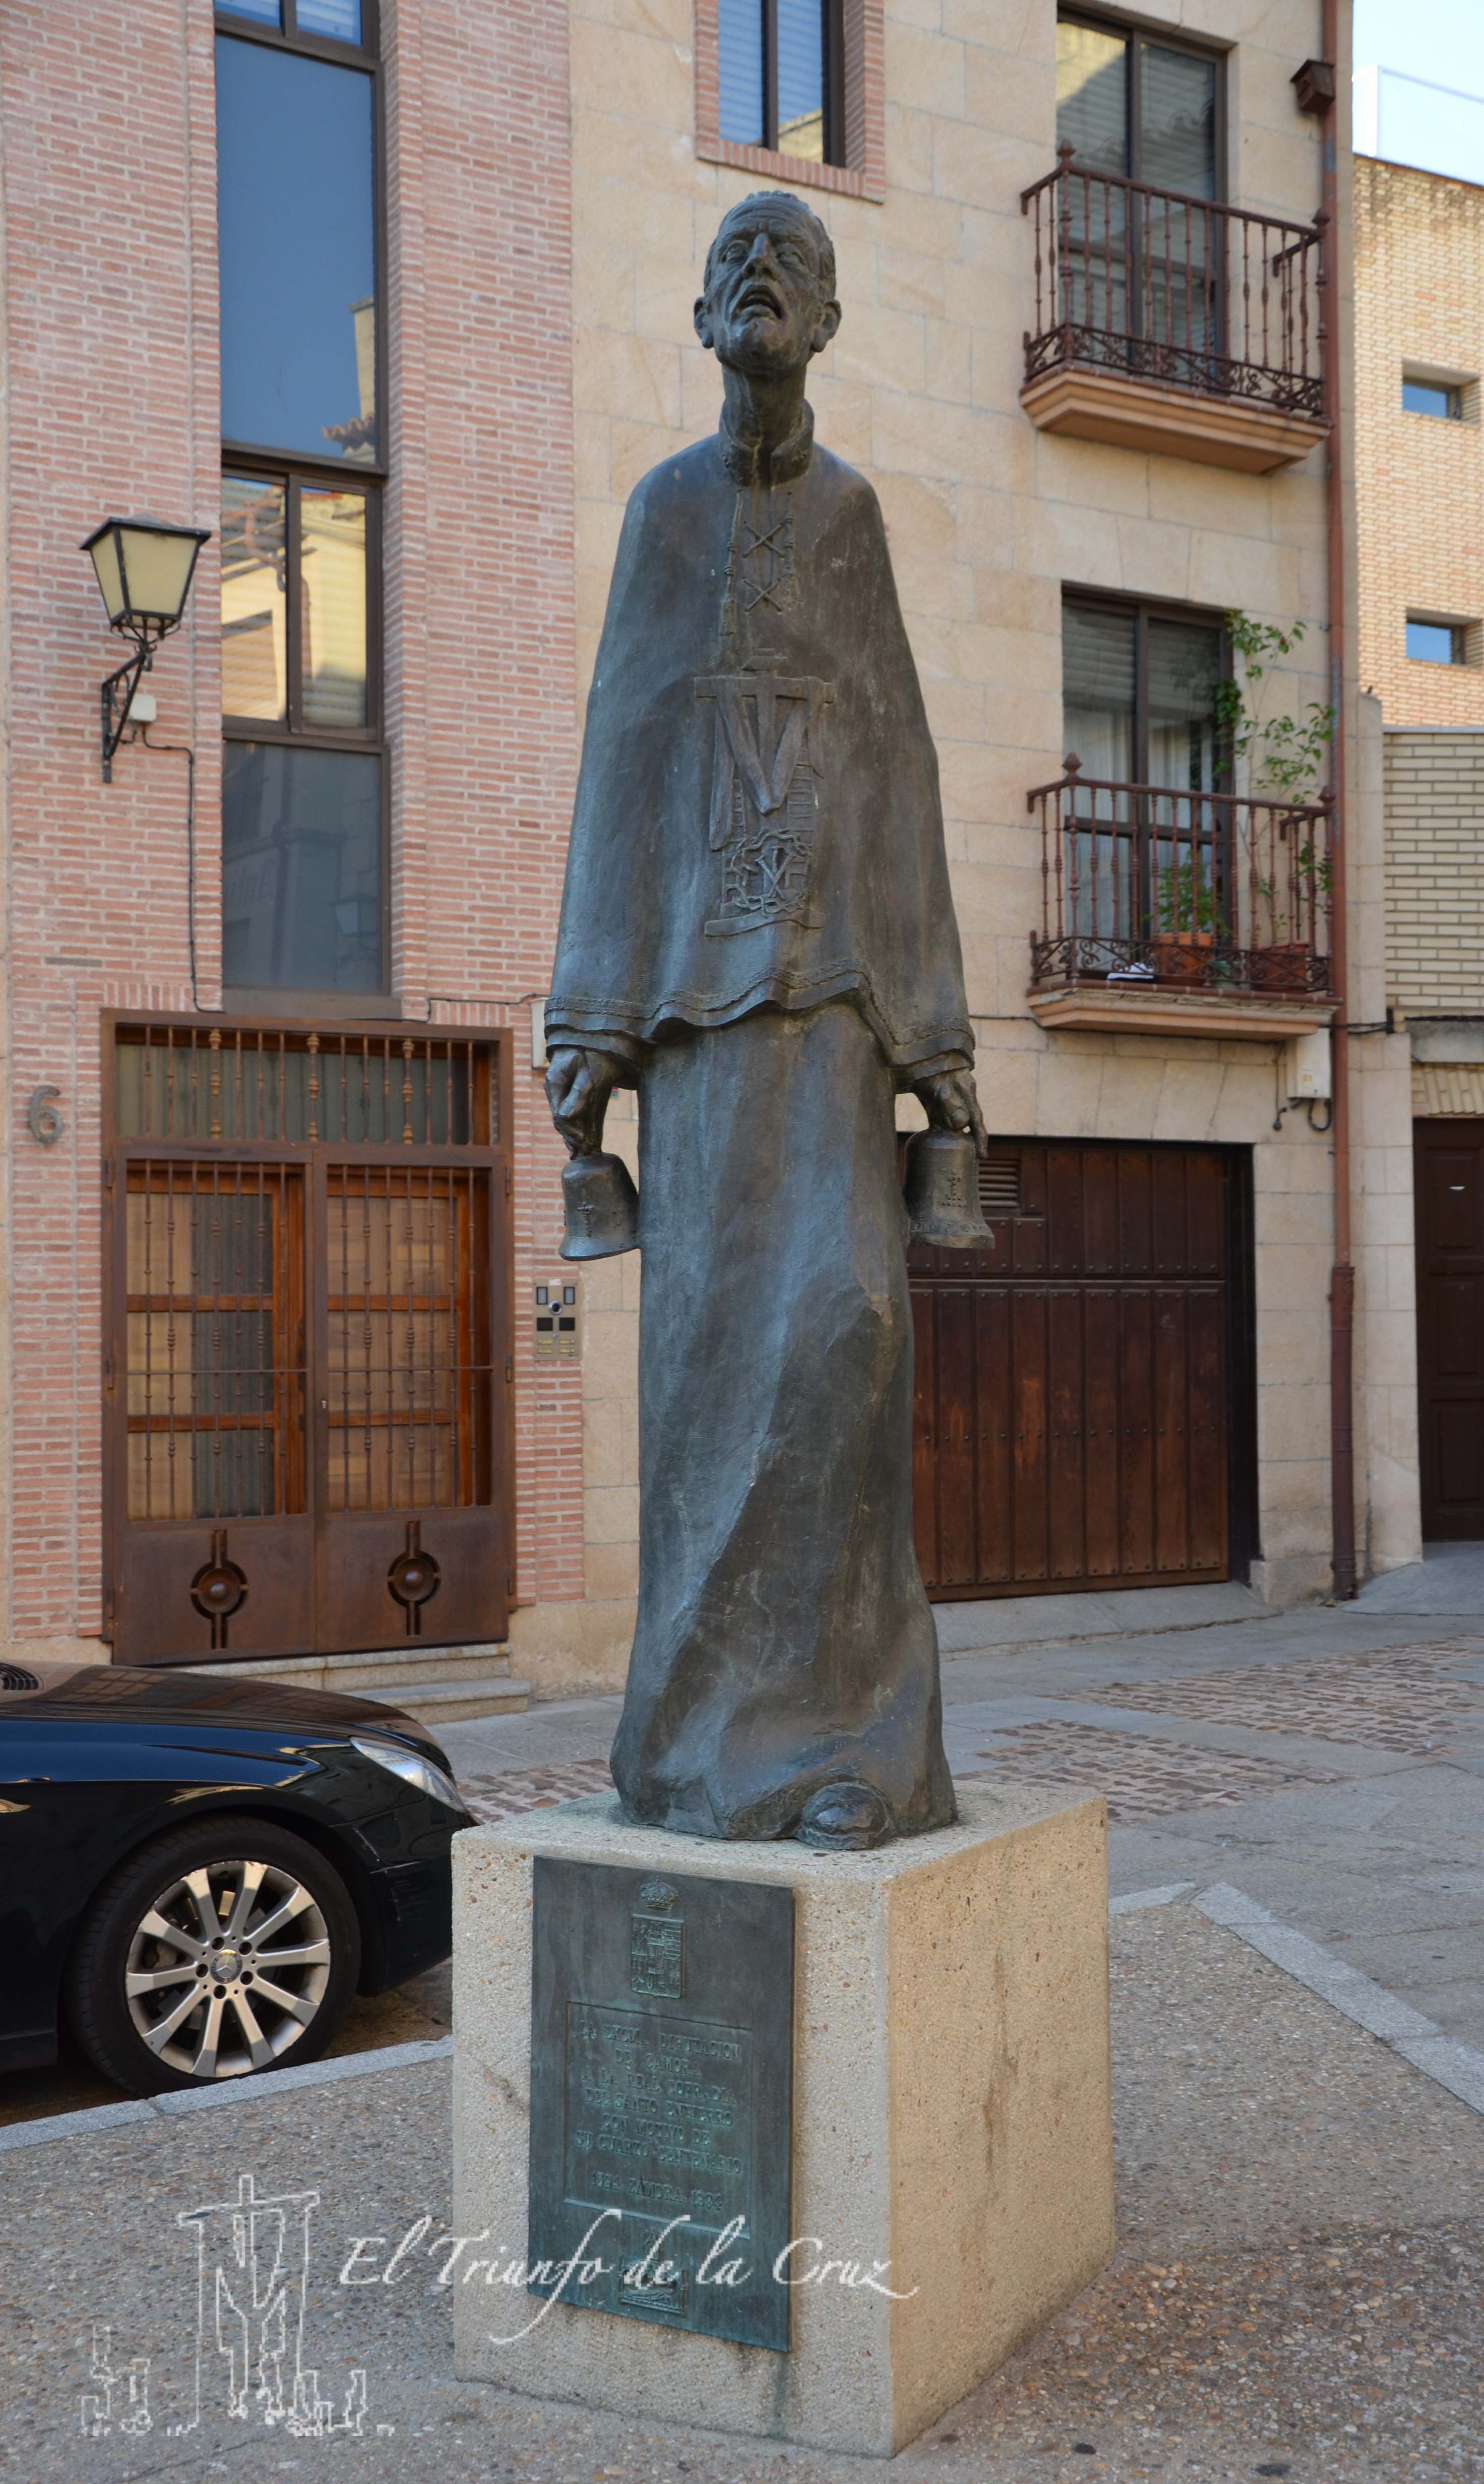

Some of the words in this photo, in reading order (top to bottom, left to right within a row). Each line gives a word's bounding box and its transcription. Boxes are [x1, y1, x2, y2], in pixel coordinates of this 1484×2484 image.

[28, 1085, 64, 1146] 6
[580, 2020, 597, 2040] LA
[581, 2065, 593, 2081] A
[600, 2068, 617, 2085] LA
[626, 2072, 661, 2092] REAL
[615, 2047, 633, 2065] DE
[645, 2053, 702, 2077] ZAMORA
[584, 2088, 609, 2105] DEL
[614, 2093, 658, 2114] SANTO
[665, 2100, 734, 2126] ENTIERRO
[601, 2113, 630, 2130] CON
[634, 2119, 685, 2141] MOTIVO
[691, 2128, 710, 2146] DE
[576, 2130, 592, 2148] SU
[598, 2134, 649, 2157] CUARTO
[658, 2146, 742, 2174] CENTENARIO
